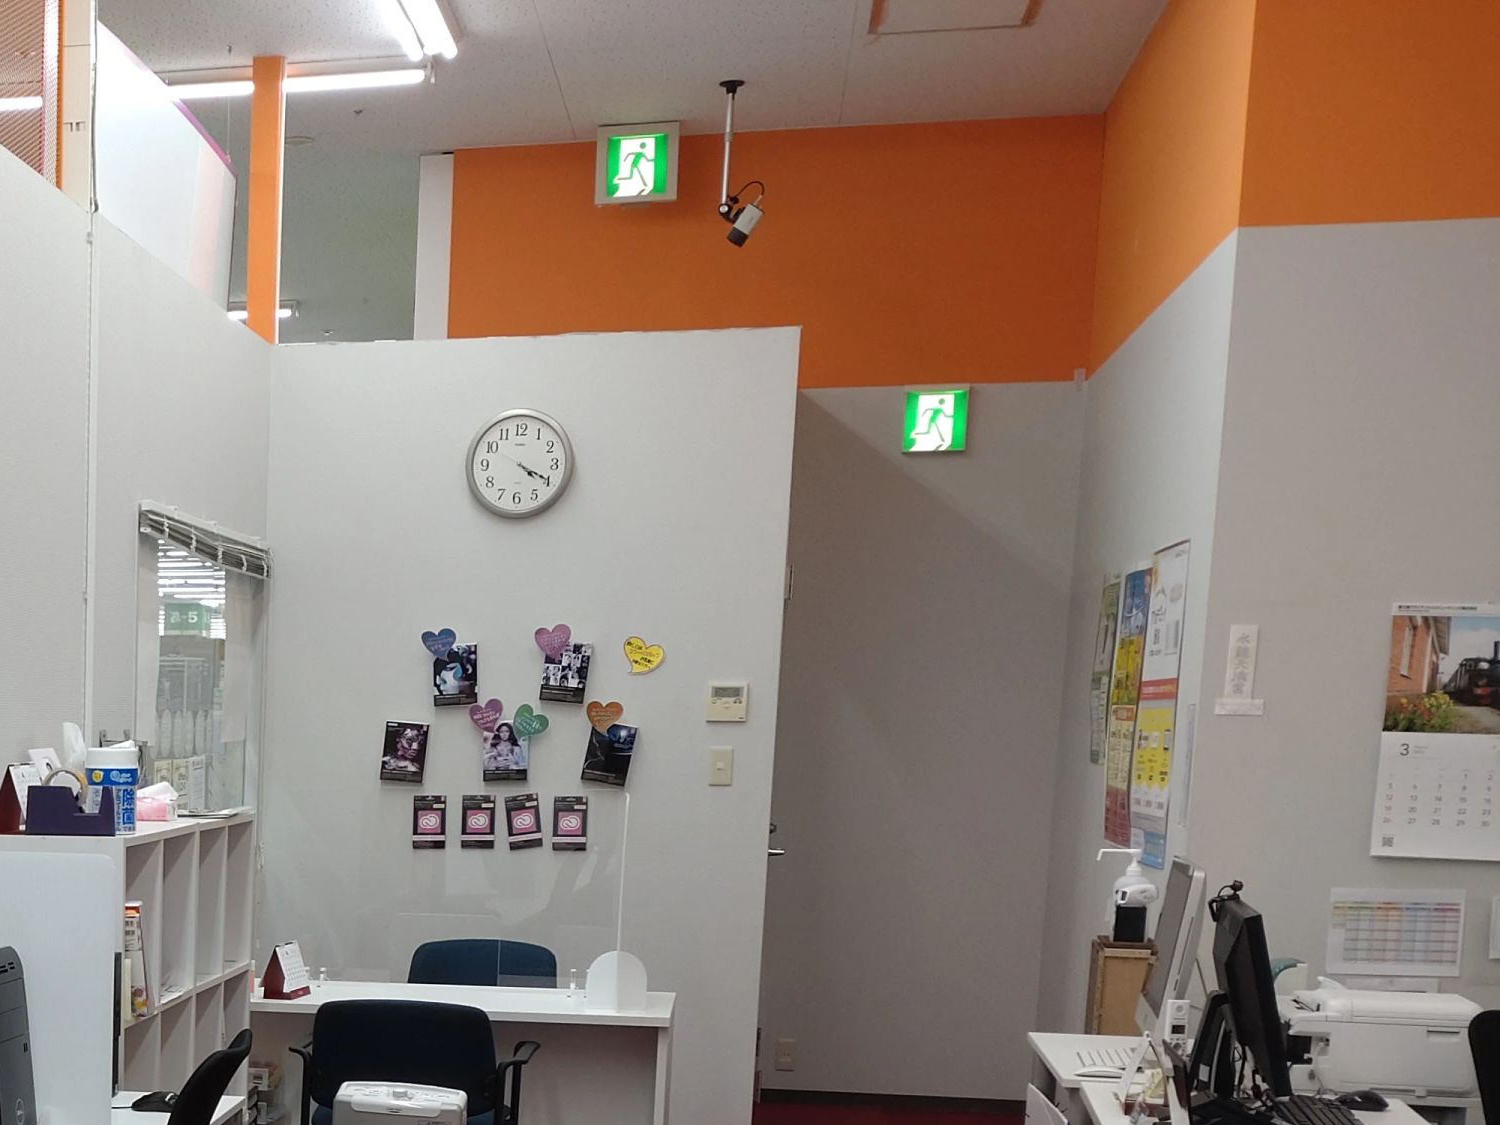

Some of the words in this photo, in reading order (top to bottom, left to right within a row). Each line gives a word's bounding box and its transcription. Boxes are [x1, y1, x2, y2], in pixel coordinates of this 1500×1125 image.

[499, 428, 509, 440] 11
[515, 423, 528, 436] 12
[537, 427, 541, 440] 1
[486, 441, 499, 453] 10
[546, 440, 554, 453] 2
[480, 458, 490, 471] 9
[550, 458, 559, 470] 3
[486, 476, 495, 488] 8
[497, 488, 506, 500] 7
[512, 492, 521, 504] 6
[530, 489, 538, 500] 5
[1400, 743, 1410, 756] 3
[122, 789, 135, 825] 除菌
